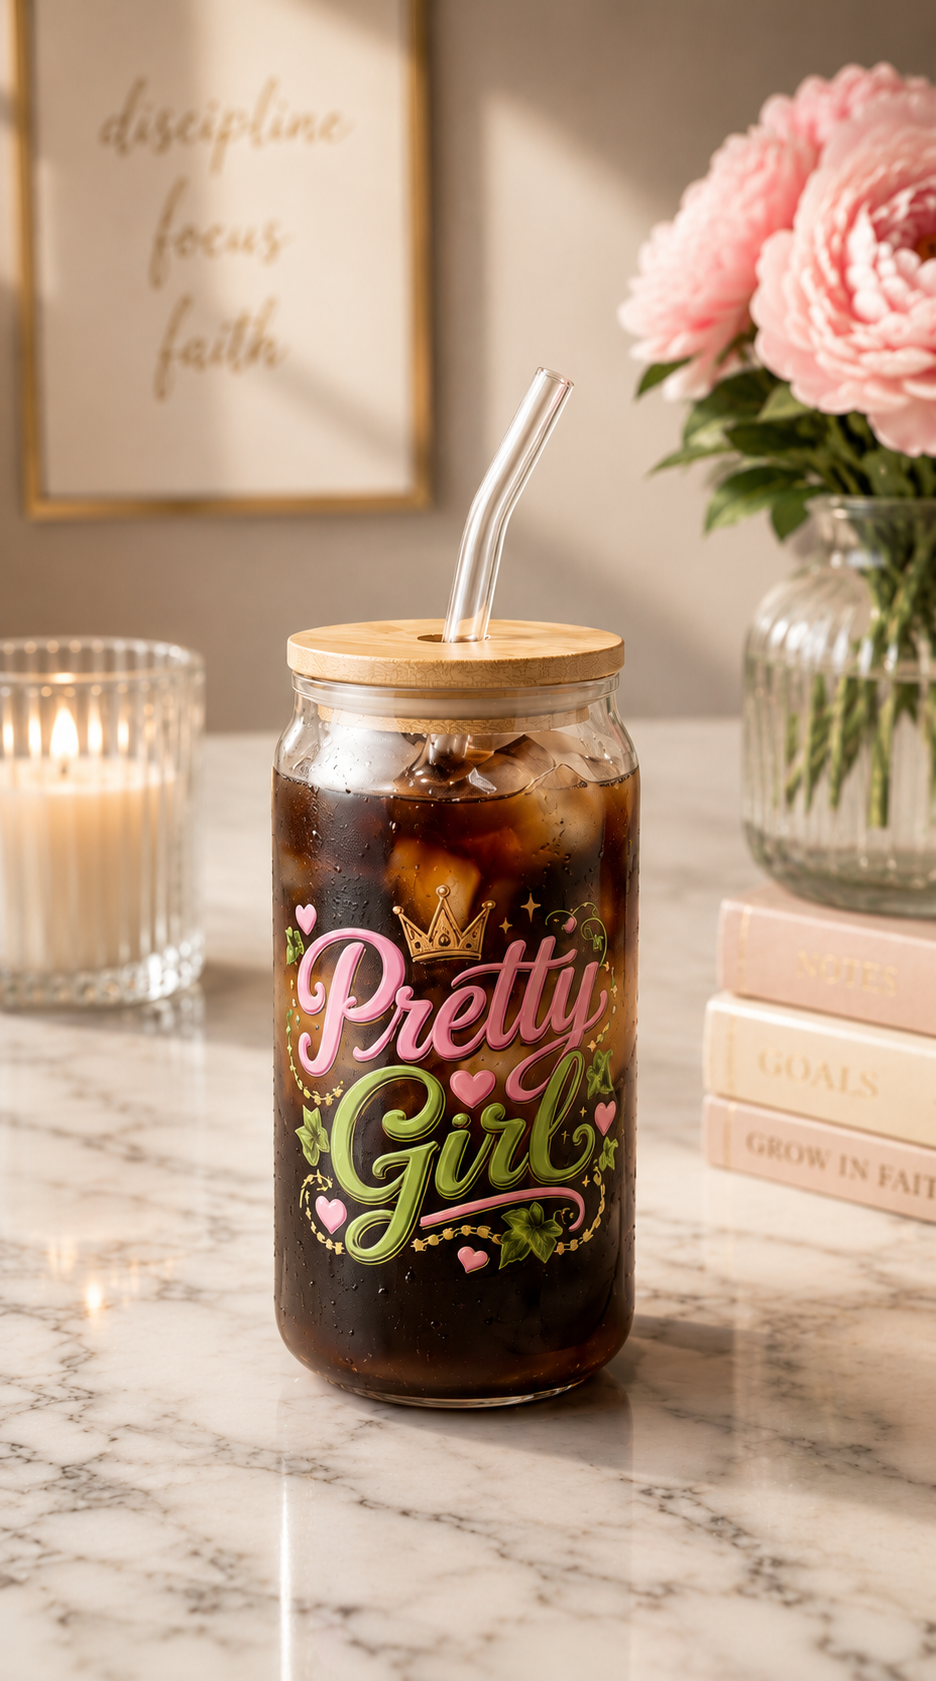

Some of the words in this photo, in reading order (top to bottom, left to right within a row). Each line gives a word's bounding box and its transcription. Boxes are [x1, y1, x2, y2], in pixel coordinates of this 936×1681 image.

[101, 77, 350, 175] discipline
[149, 176, 287, 289] focus
[155, 295, 285, 401] faith
[297, 927, 608, 1105] Pretty
[797, 950, 899, 997] NOTES
[758, 1048, 879, 1099] GOALS
[331, 1050, 596, 1265] Girl
[746, 1131, 831, 1171] GROW
[838, 1156, 870, 1181] IN
